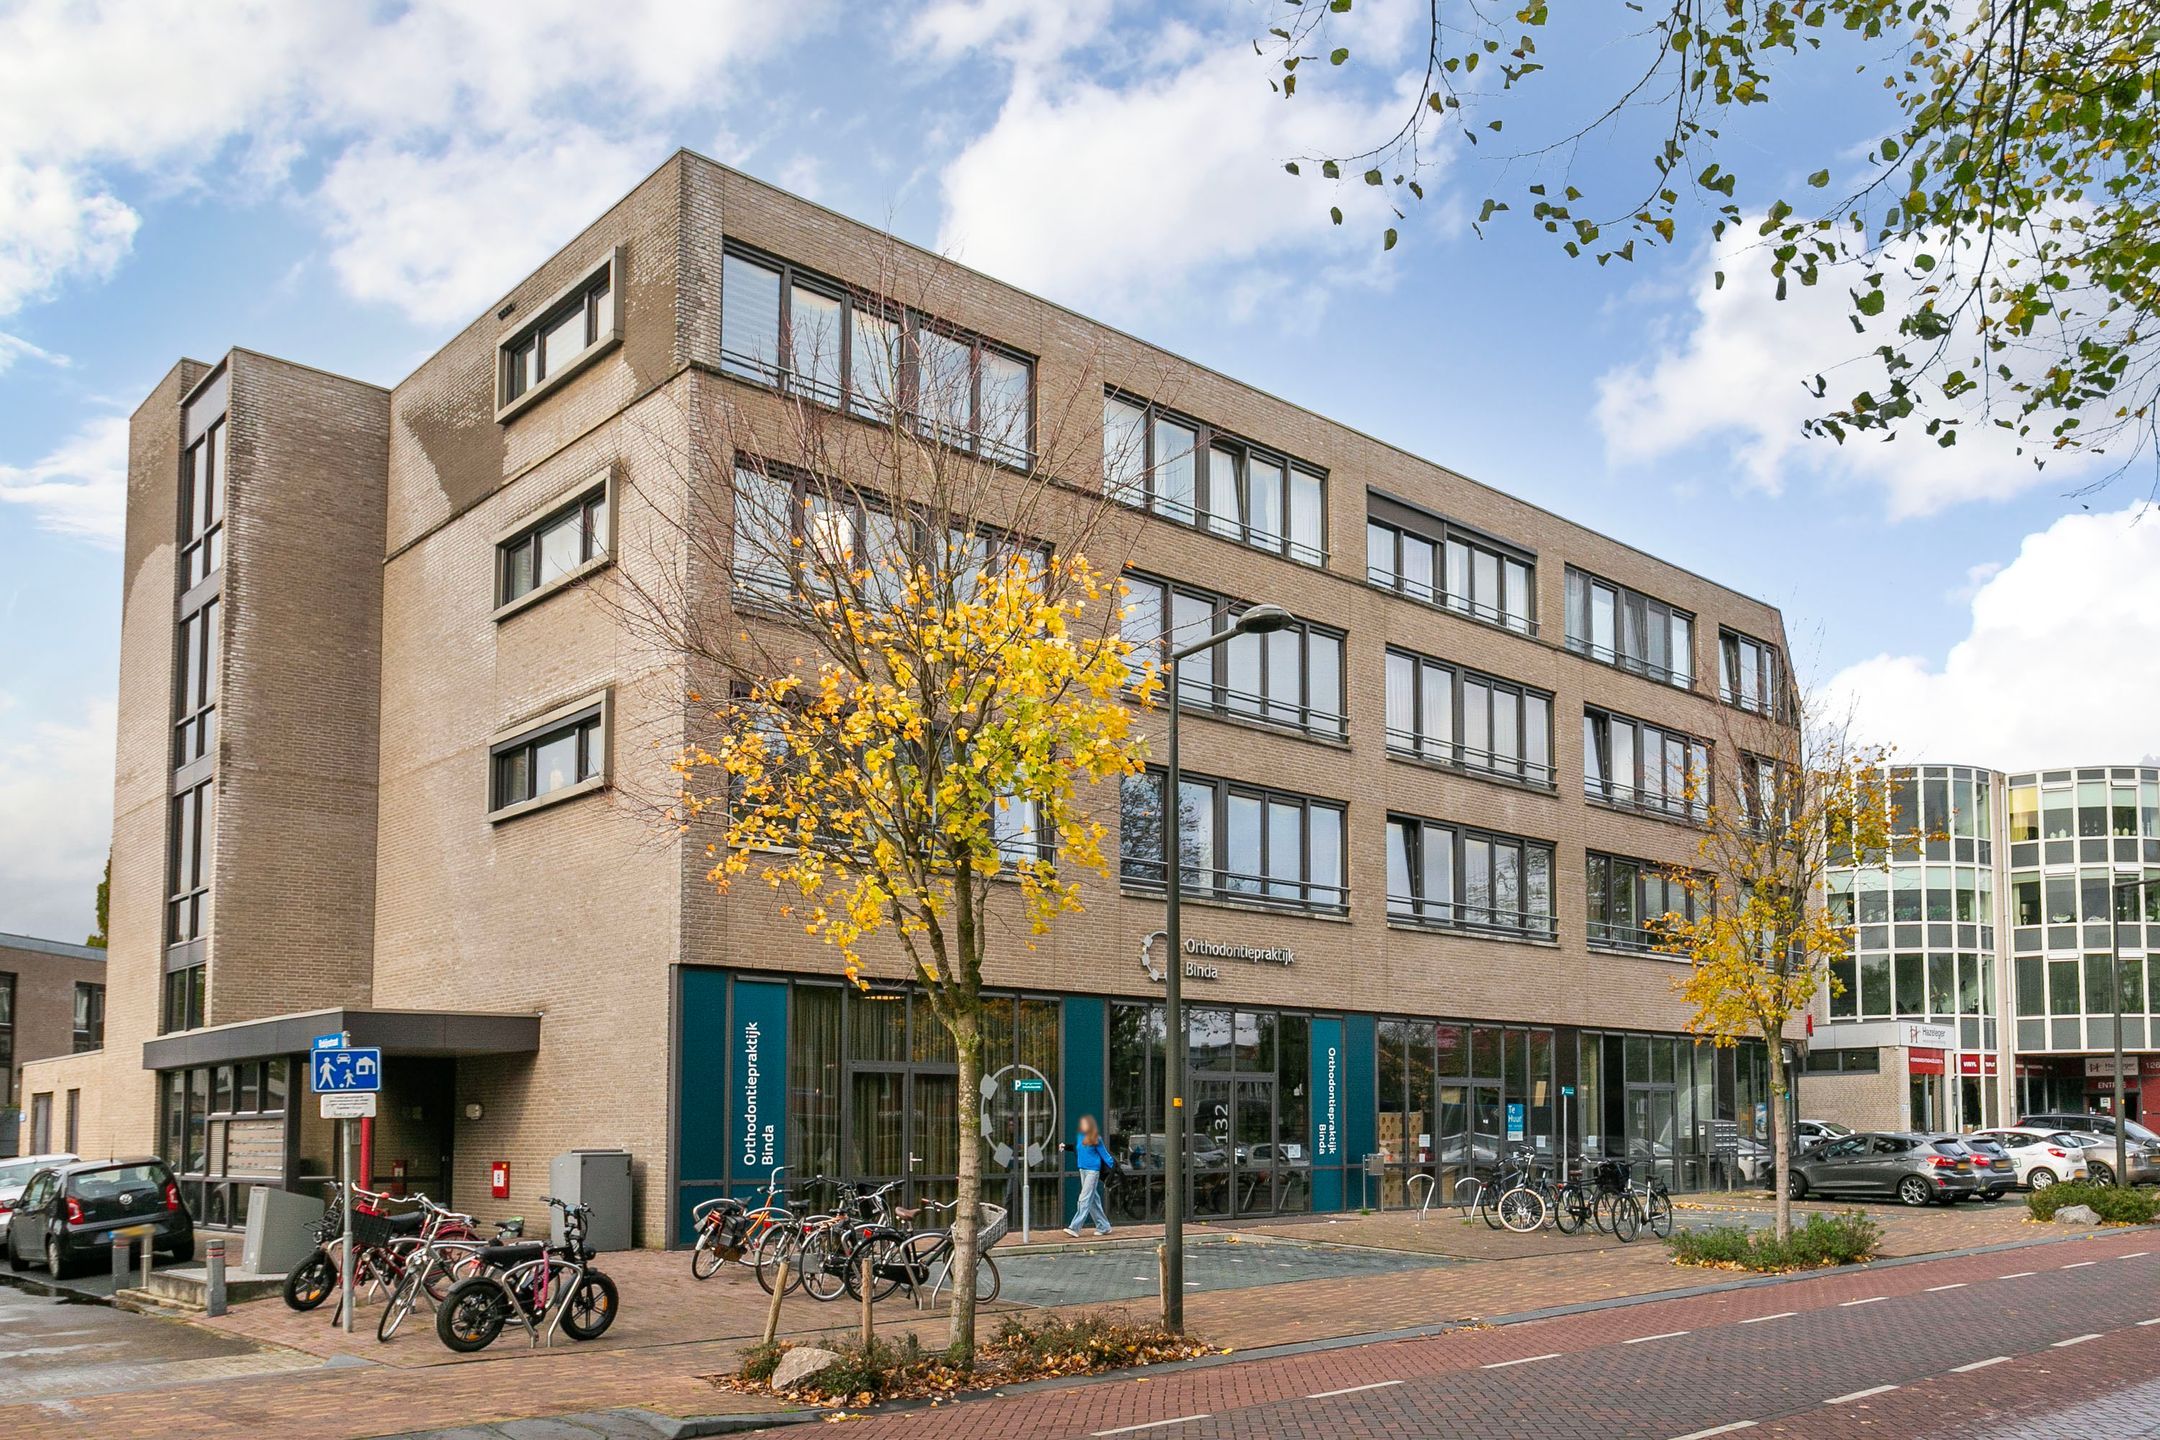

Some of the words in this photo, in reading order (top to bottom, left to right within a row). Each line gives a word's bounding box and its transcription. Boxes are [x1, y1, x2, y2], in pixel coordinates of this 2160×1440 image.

[1186, 938, 1294, 965] Orthodontiepraktijk
[1186, 962, 1218, 978] Binda
[744, 1022, 760, 1165] Orthodontiepraktijk
[1015, 1080, 1021, 1090] P
[1327, 1047, 1336, 1154] Orthodontiepraktijk
[1215, 1104, 1228, 1143] 132
[1508, 1105, 1516, 1114] Te
[762, 1125, 774, 1165] Binda
